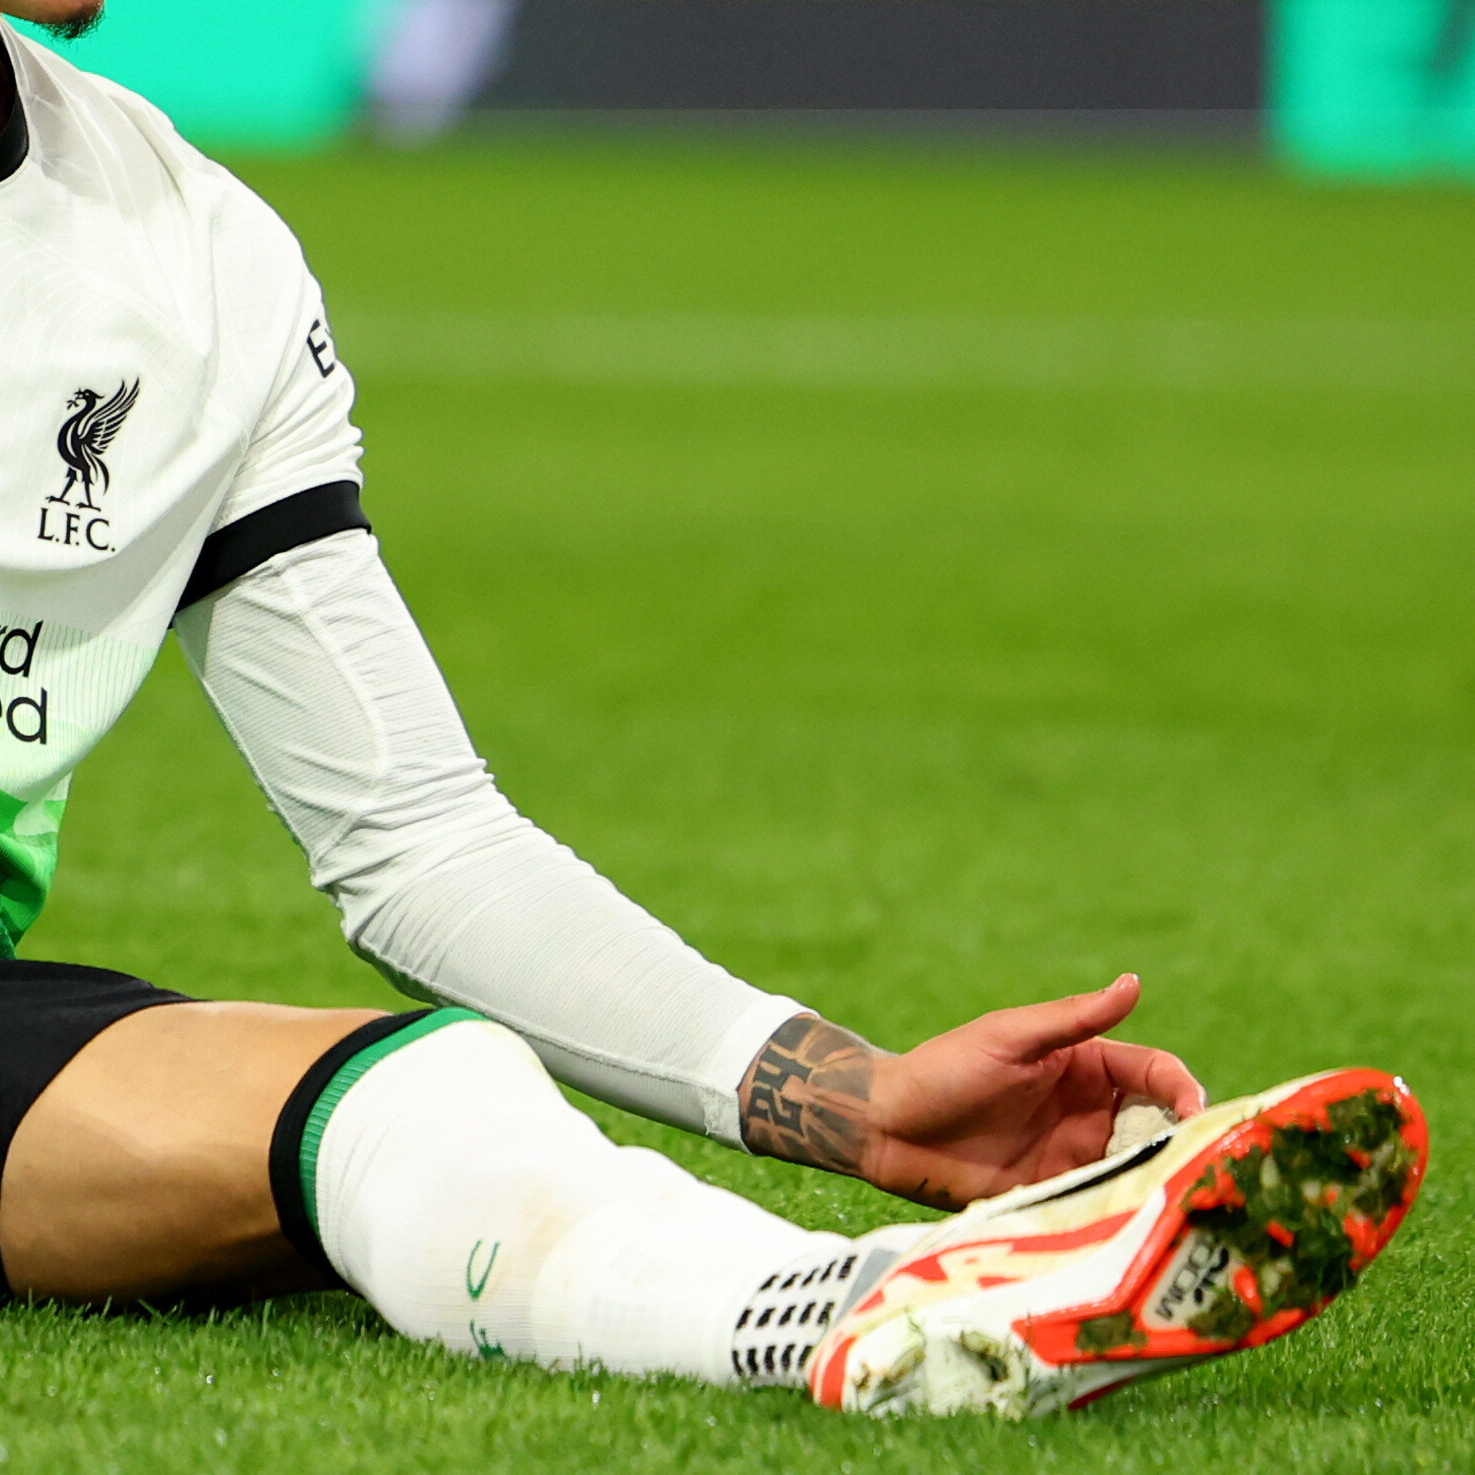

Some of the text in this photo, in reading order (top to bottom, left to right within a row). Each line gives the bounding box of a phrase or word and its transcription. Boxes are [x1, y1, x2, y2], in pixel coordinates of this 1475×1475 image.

[307, 318, 335, 378] E
[37, 507, 116, 552] L.F.C.
[1155, 1226, 1214, 1322] OOM
